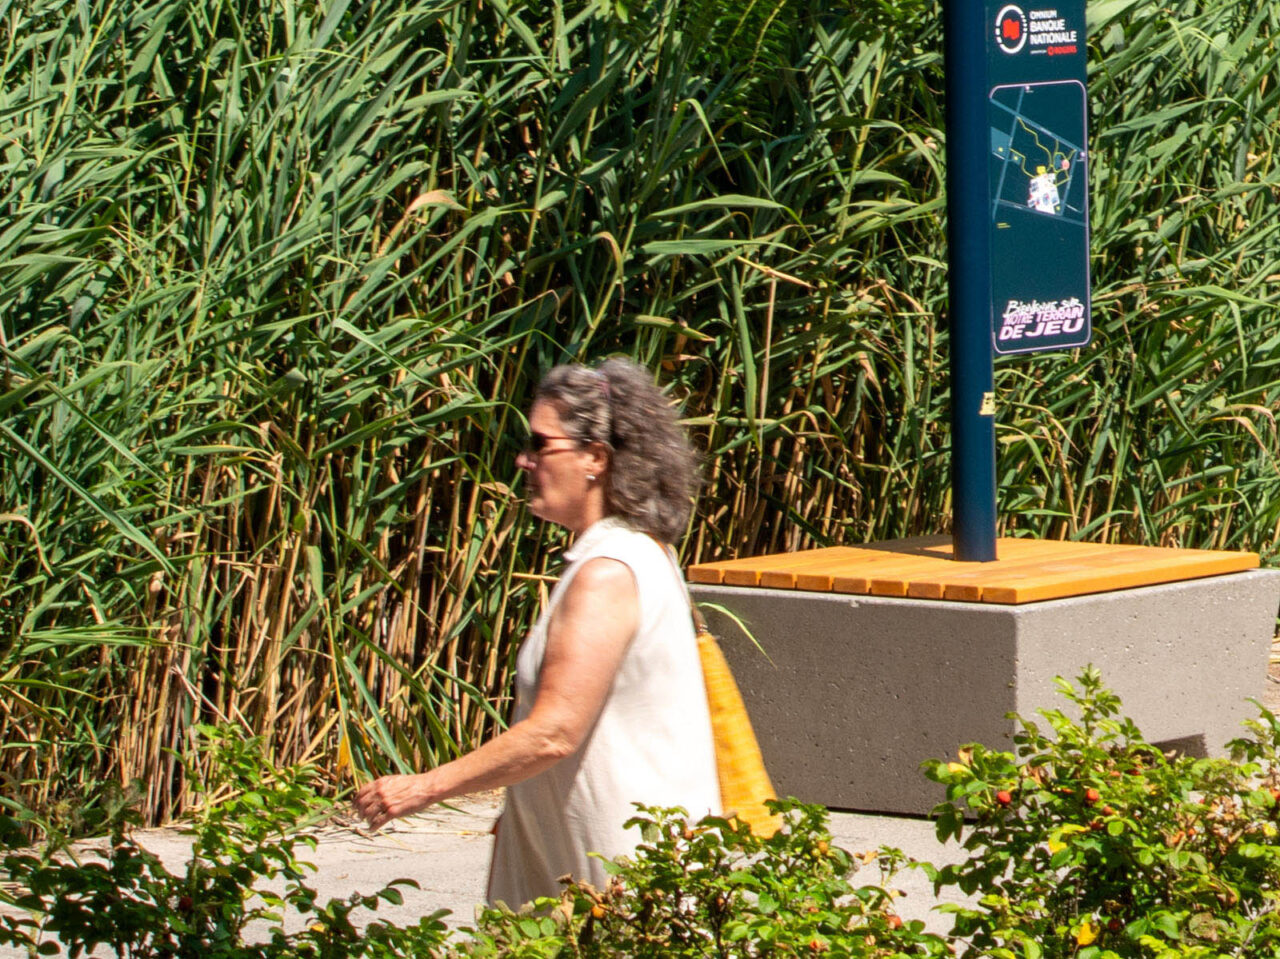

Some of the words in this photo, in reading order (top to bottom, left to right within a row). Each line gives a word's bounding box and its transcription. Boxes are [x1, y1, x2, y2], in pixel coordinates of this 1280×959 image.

[1030, 10, 1058, 20] OMNIUM
[1030, 20, 1066, 32] BANQUE
[1030, 32, 1077, 44] NATIONALE
[1003, 312, 1034, 326] NOTRE
[1036, 306, 1085, 323] TERRAIN
[999, 324, 1026, 340] DE
[1025, 318, 1085, 337] JEU
